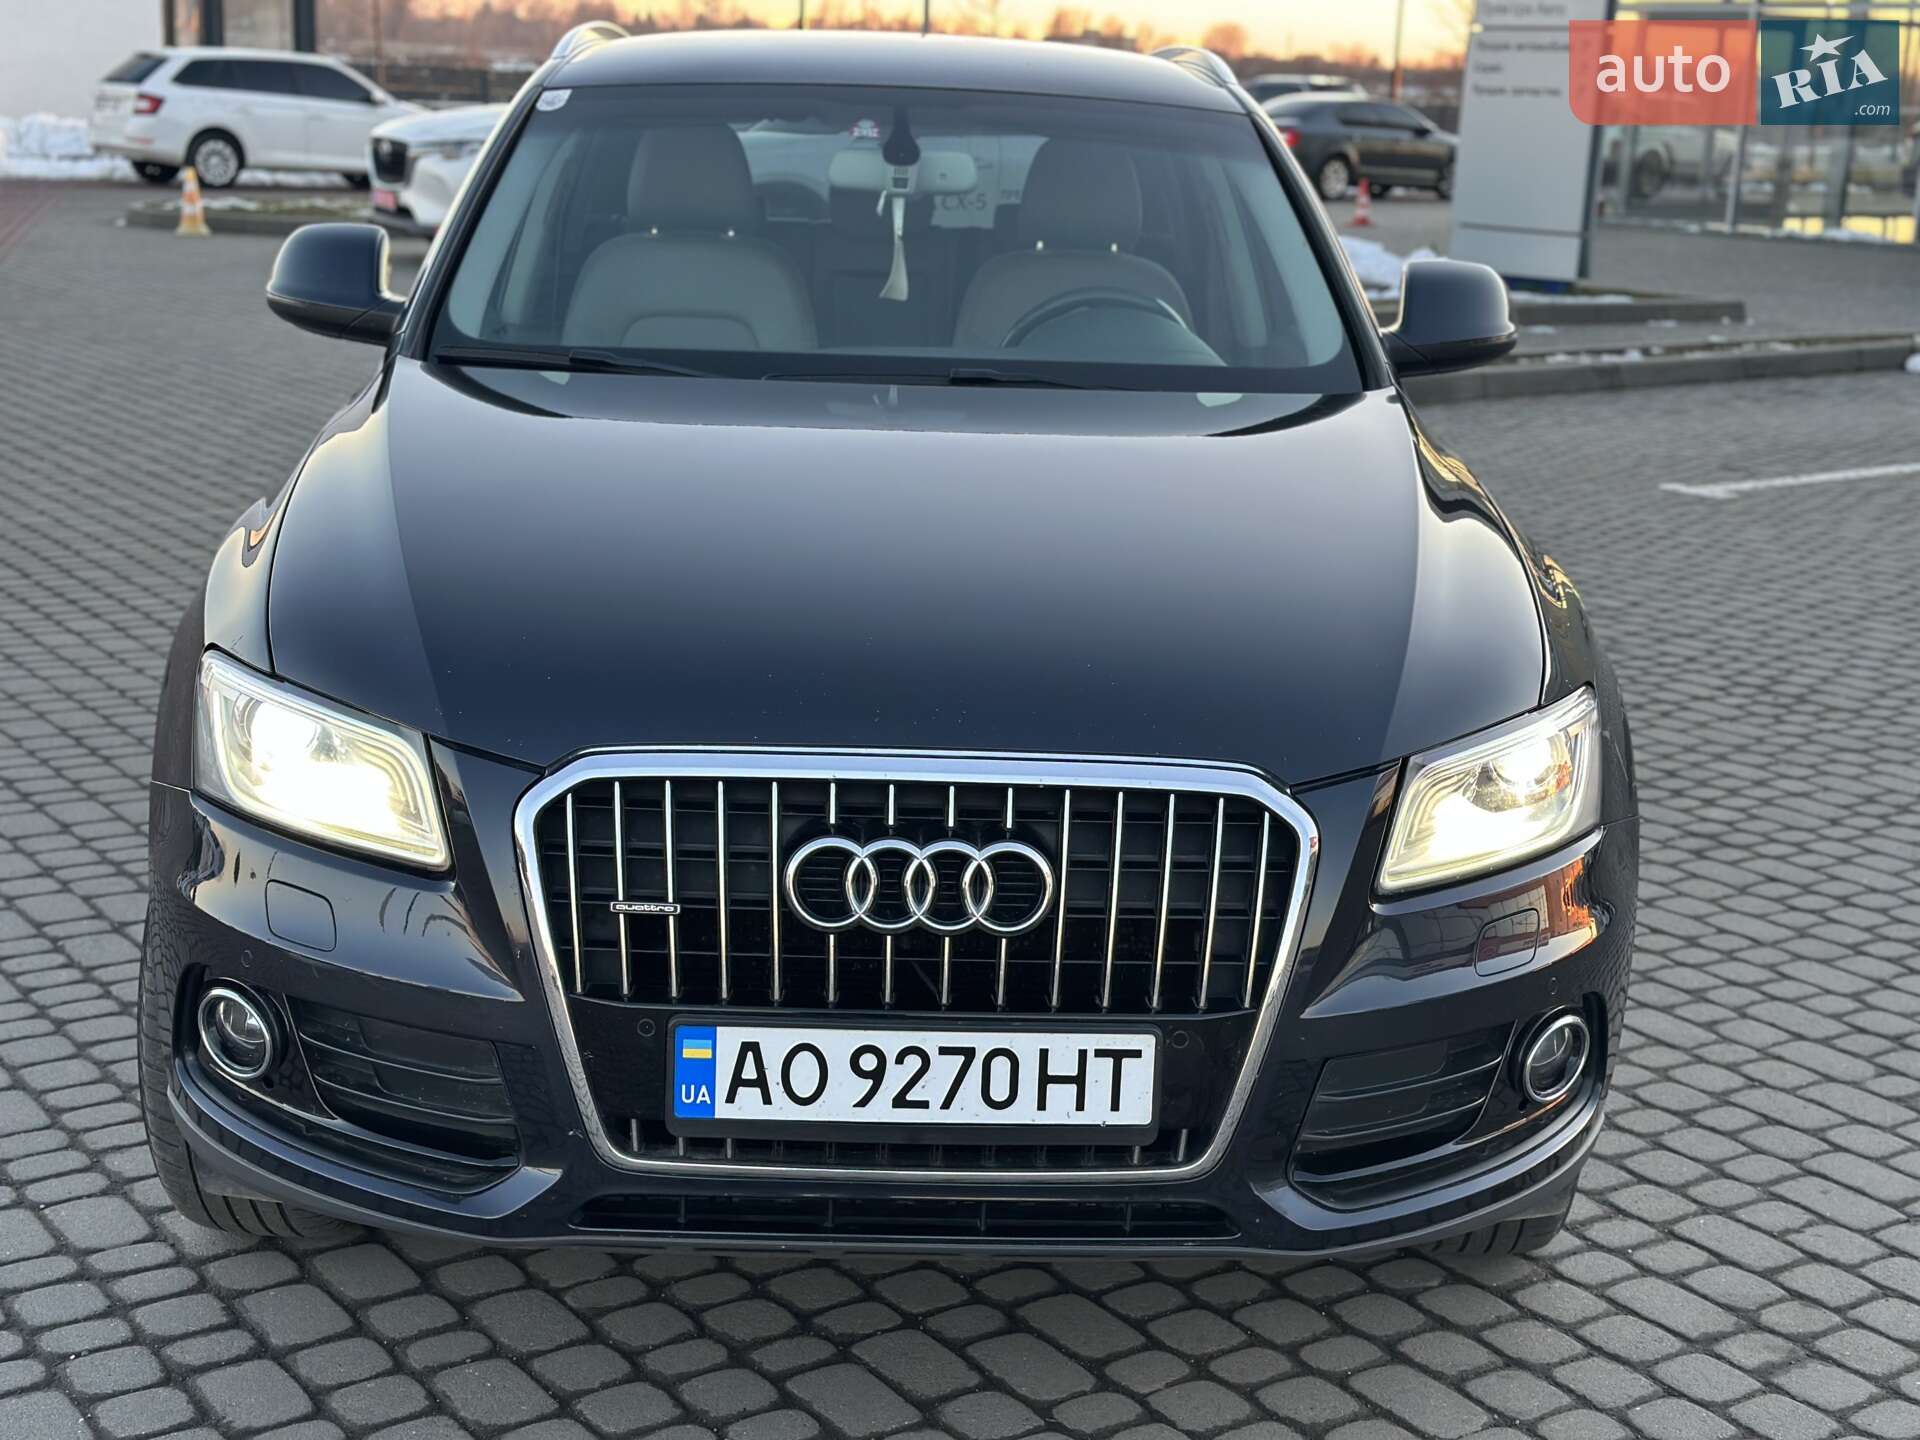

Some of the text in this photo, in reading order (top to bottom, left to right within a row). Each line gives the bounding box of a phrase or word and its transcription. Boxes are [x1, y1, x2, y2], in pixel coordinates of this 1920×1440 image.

[615, 904, 675, 912] quattro
[681, 1040, 1143, 1113] UA AO 9270 HT
